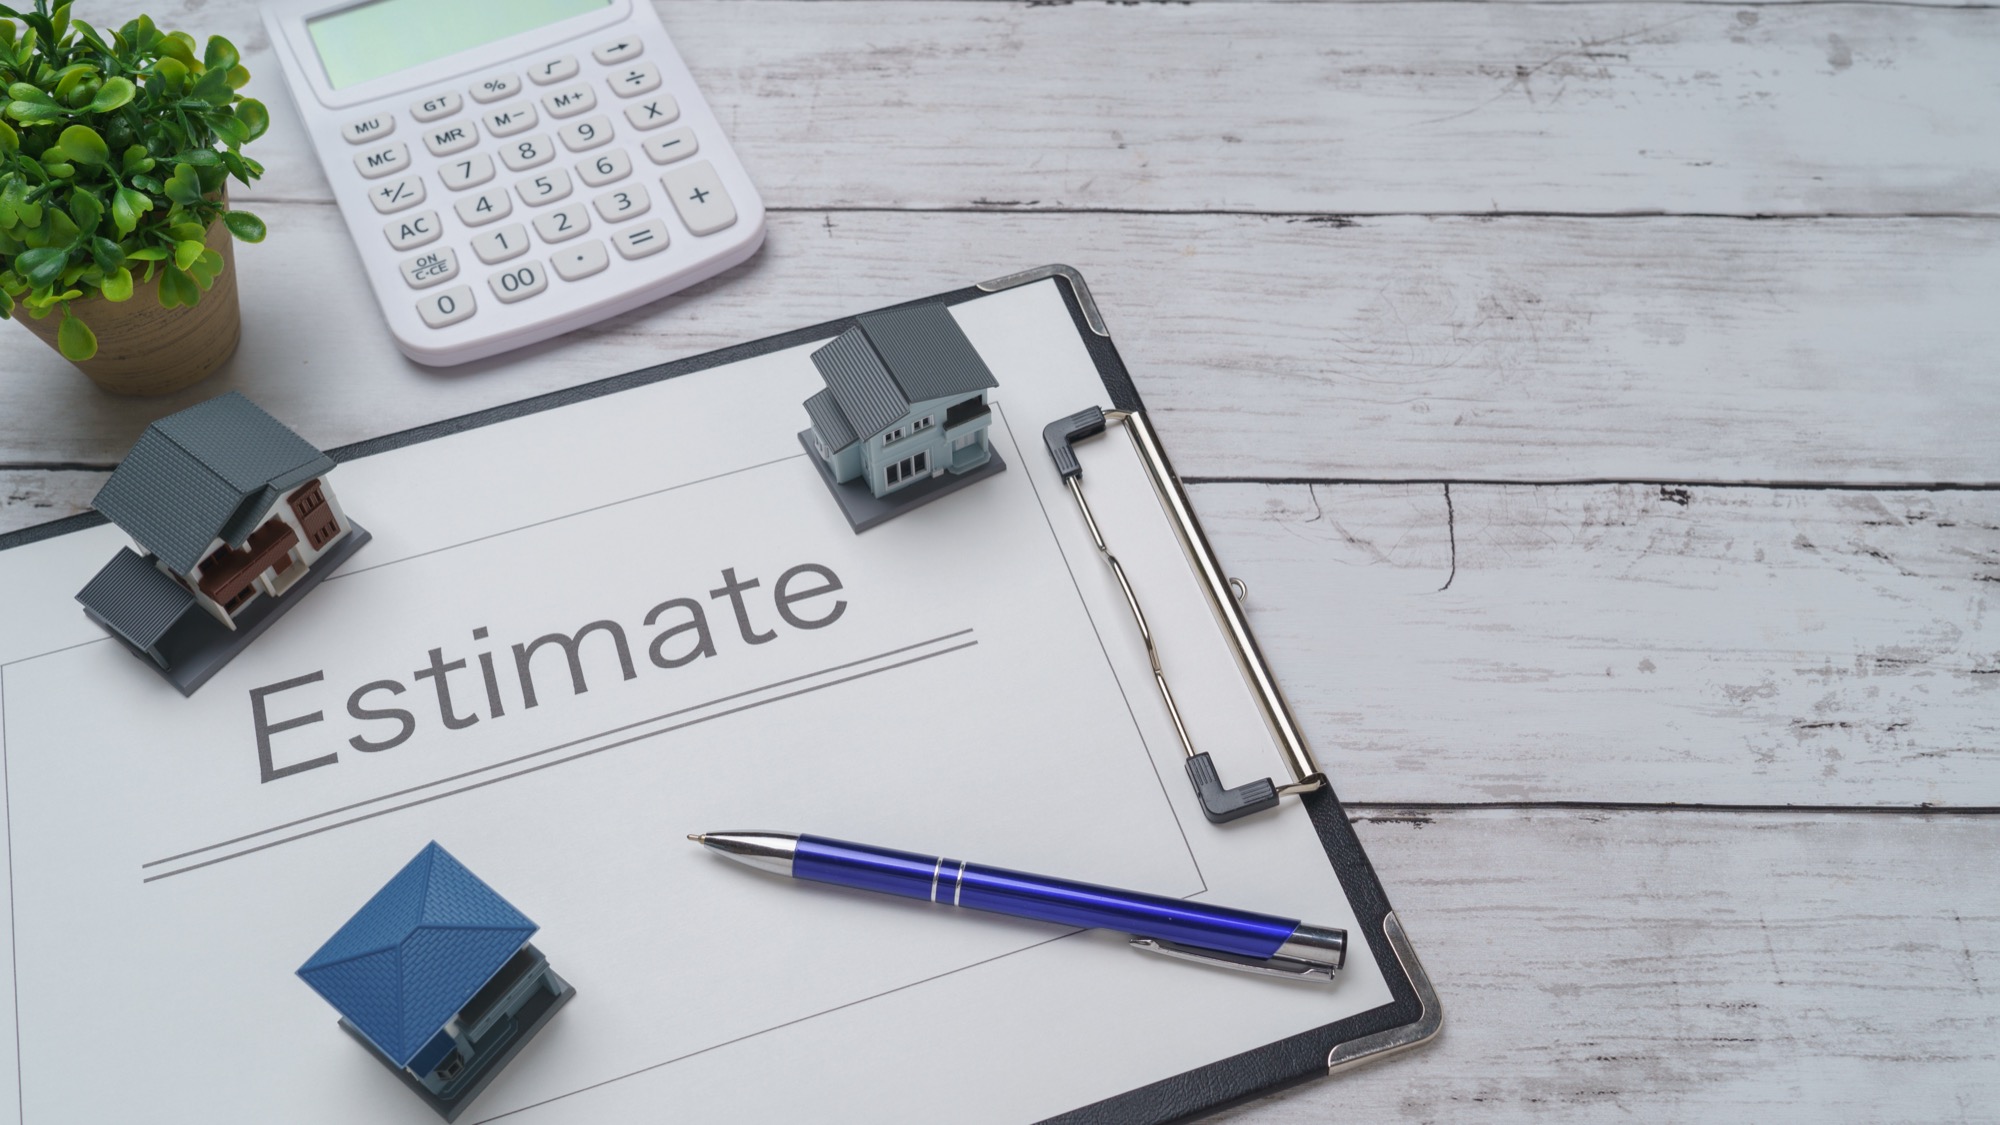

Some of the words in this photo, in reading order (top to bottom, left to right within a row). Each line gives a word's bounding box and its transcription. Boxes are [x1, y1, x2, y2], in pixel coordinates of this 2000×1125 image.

[483, 80, 507, 92] %
[423, 97, 446, 112] GT
[554, 93, 582, 107] M+
[354, 119, 380, 134] MU
[577, 123, 595, 141] 9
[435, 128, 465, 145] MR
[367, 149, 395, 168] MC
[518, 142, 537, 160] 8
[457, 161, 471, 179] 7
[596, 156, 614, 175] 6
[535, 176, 553, 195] 5
[476, 196, 493, 212] 4
[613, 192, 632, 211] 3
[401, 217, 429, 240] AC
[553, 212, 573, 232] 2
[494, 232, 509, 250] 1
[416, 253, 438, 267] ON
[501, 267, 535, 292] 00
[249, 563, 847, 784] Estimate
